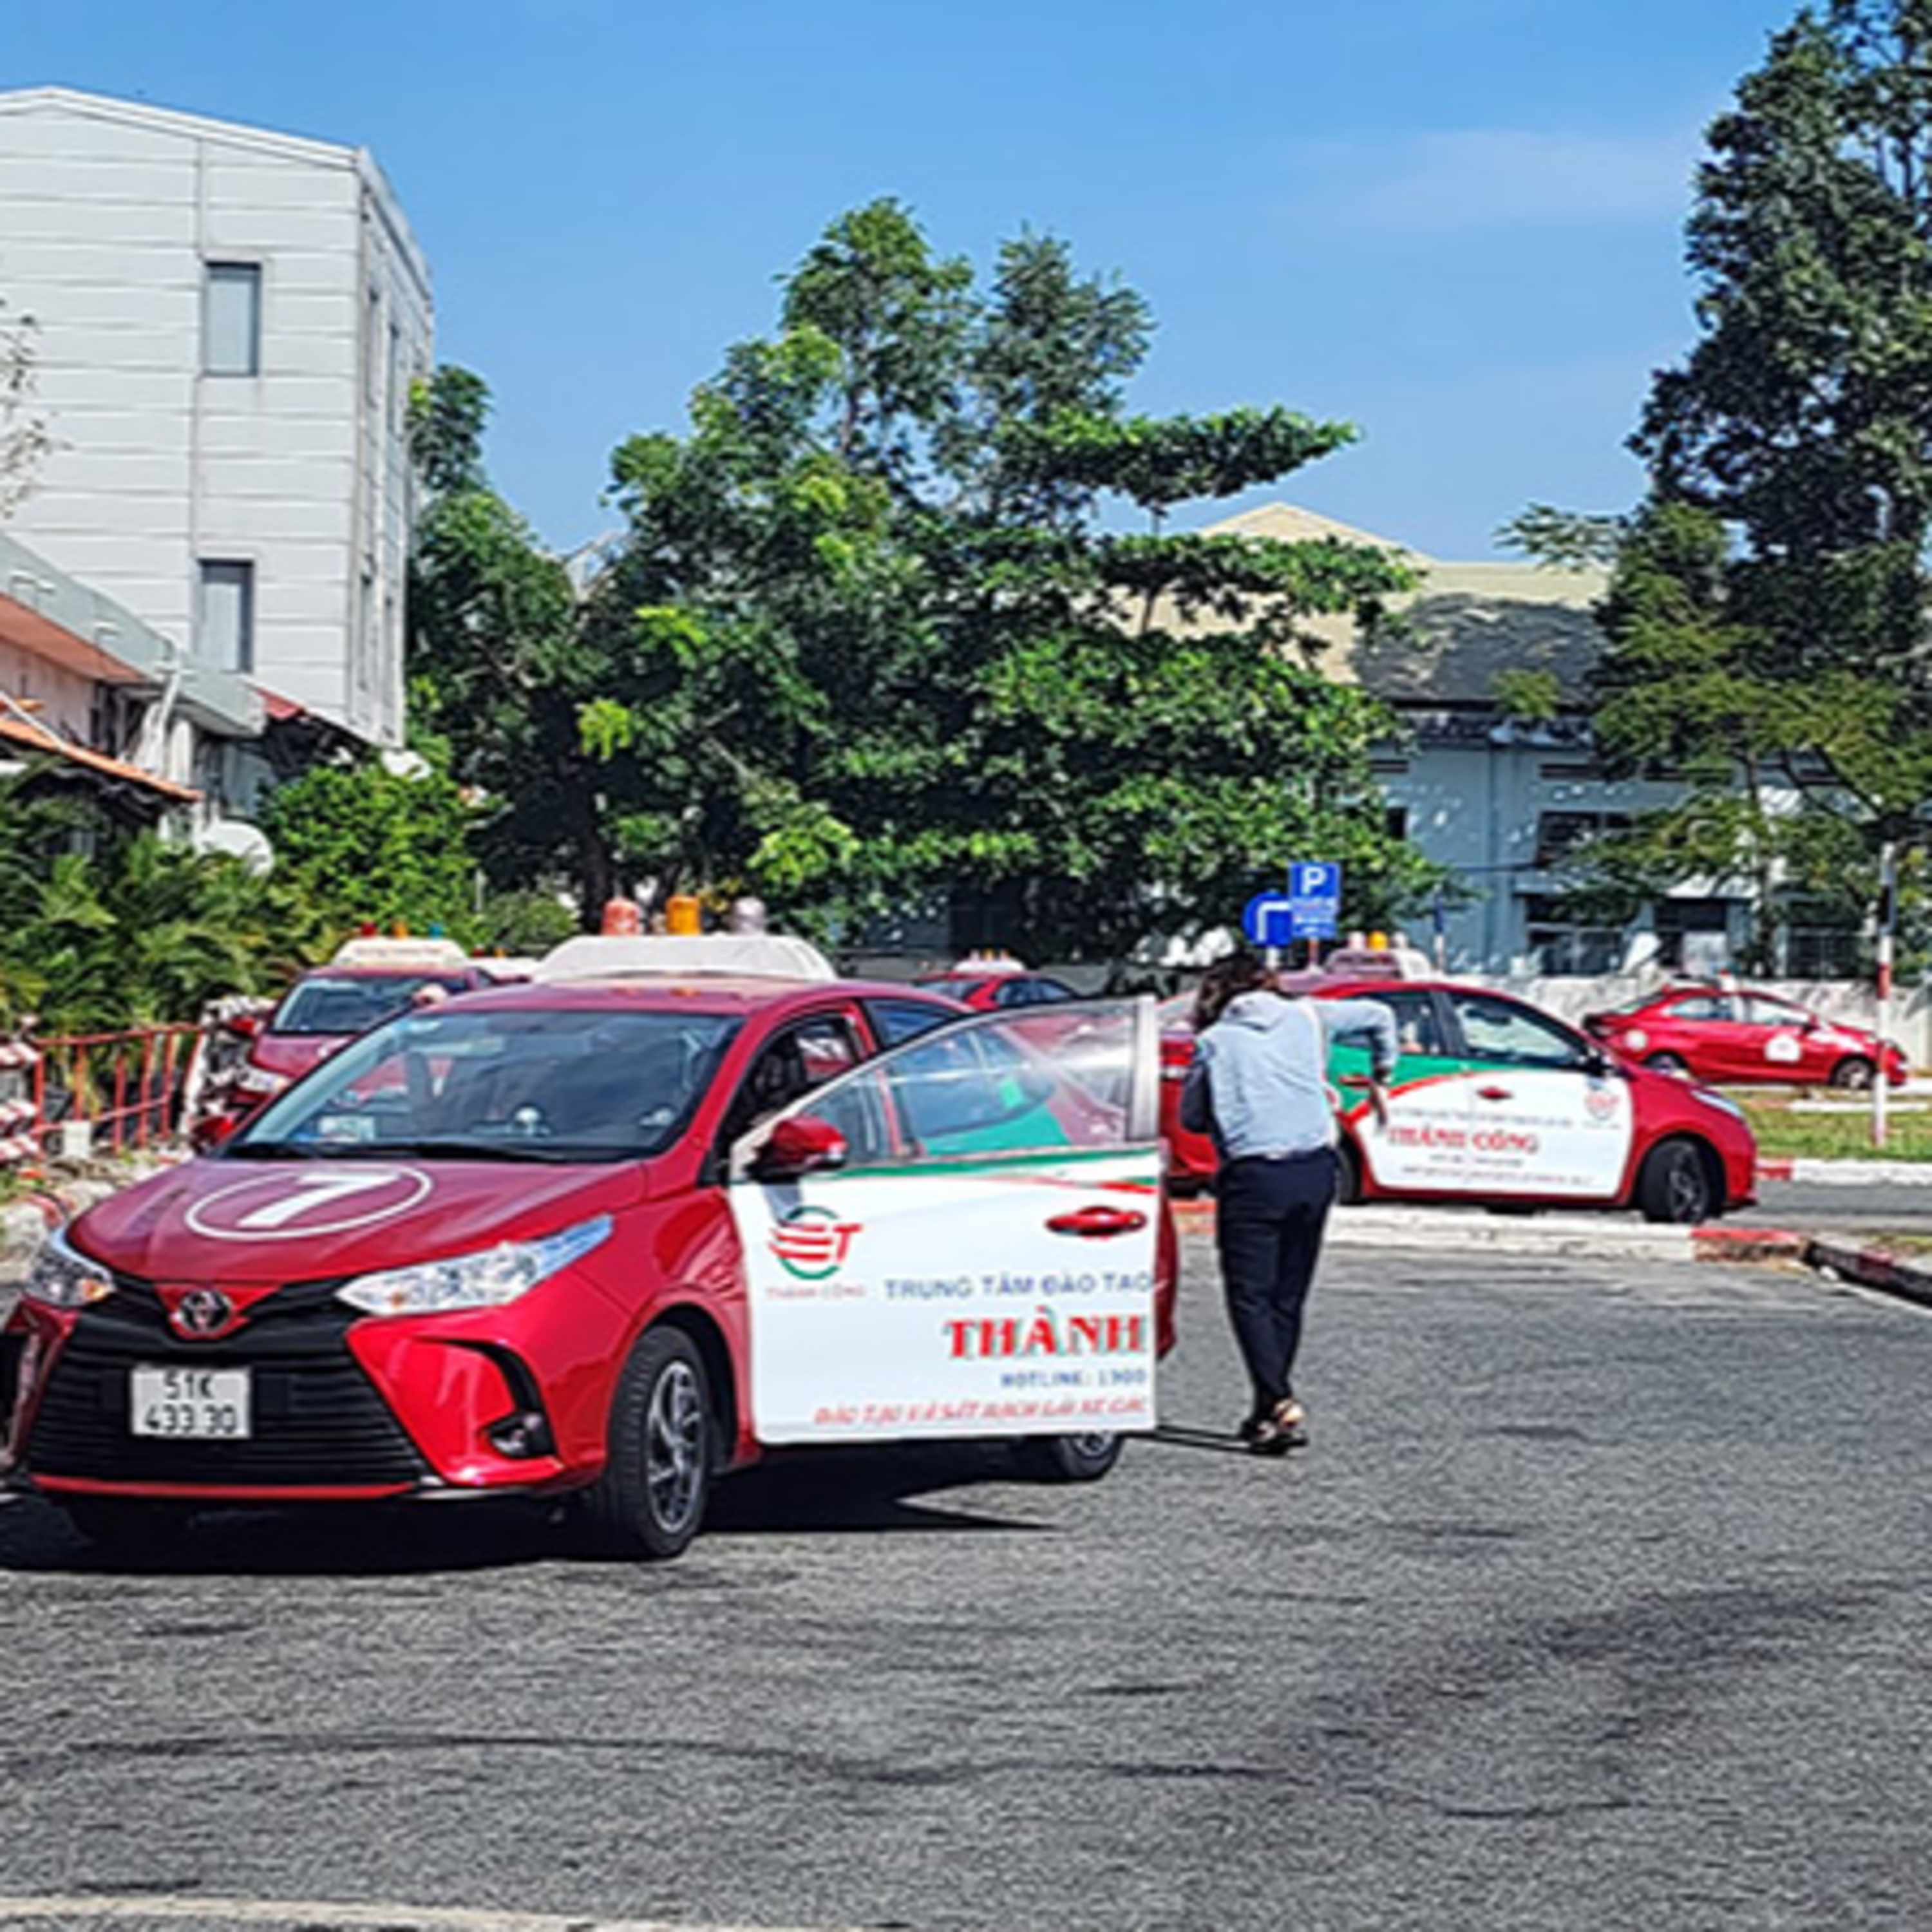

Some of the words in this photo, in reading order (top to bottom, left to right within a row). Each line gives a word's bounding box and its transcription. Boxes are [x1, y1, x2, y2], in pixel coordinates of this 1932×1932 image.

[1302, 867, 1327, 895] P
[236, 1170, 402, 1227] 7
[884, 1275, 974, 1300] TRUNG
[982, 1271, 1035, 1296] TÂM
[942, 1304, 1148, 1359] THÀNH
